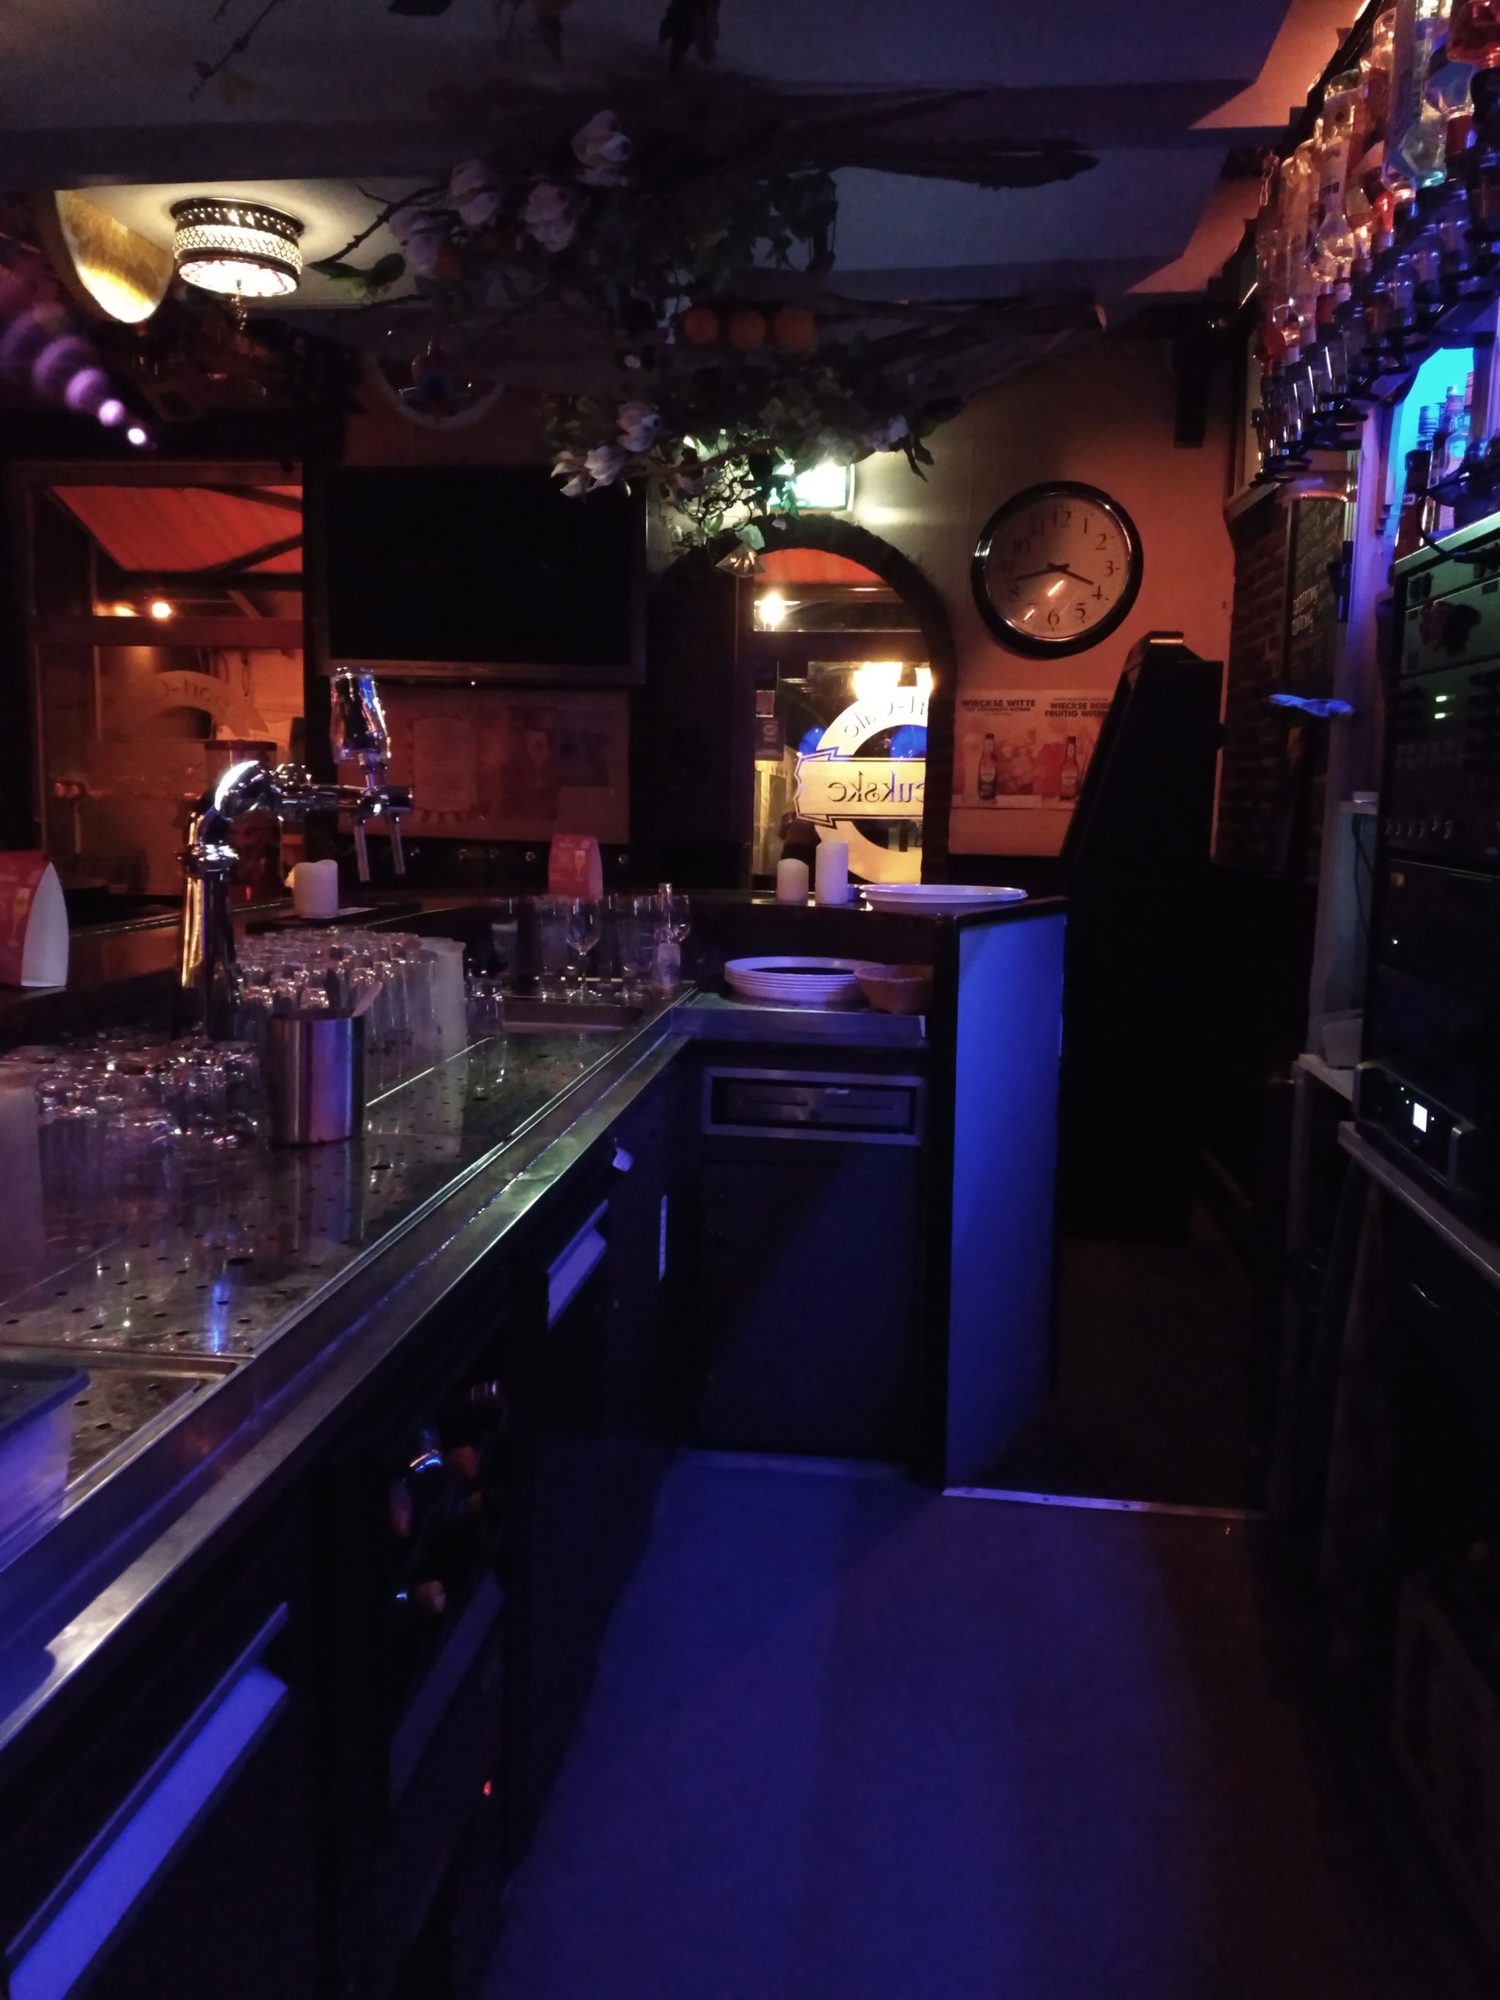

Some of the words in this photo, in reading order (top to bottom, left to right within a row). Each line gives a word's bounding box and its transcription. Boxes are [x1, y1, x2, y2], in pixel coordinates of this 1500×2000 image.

[1052, 508, 1072, 528] 12
[1083, 517, 1089, 535] 1
[1095, 532, 1107, 551] 2
[1103, 559, 1115, 577] 3
[1091, 585, 1104, 601] 4
[1047, 609, 1060, 626] 6
[1075, 602, 1087, 620] 5
[1006, 699, 1036, 707] WITTE
[1050, 702, 1088, 710] WIECKSE
